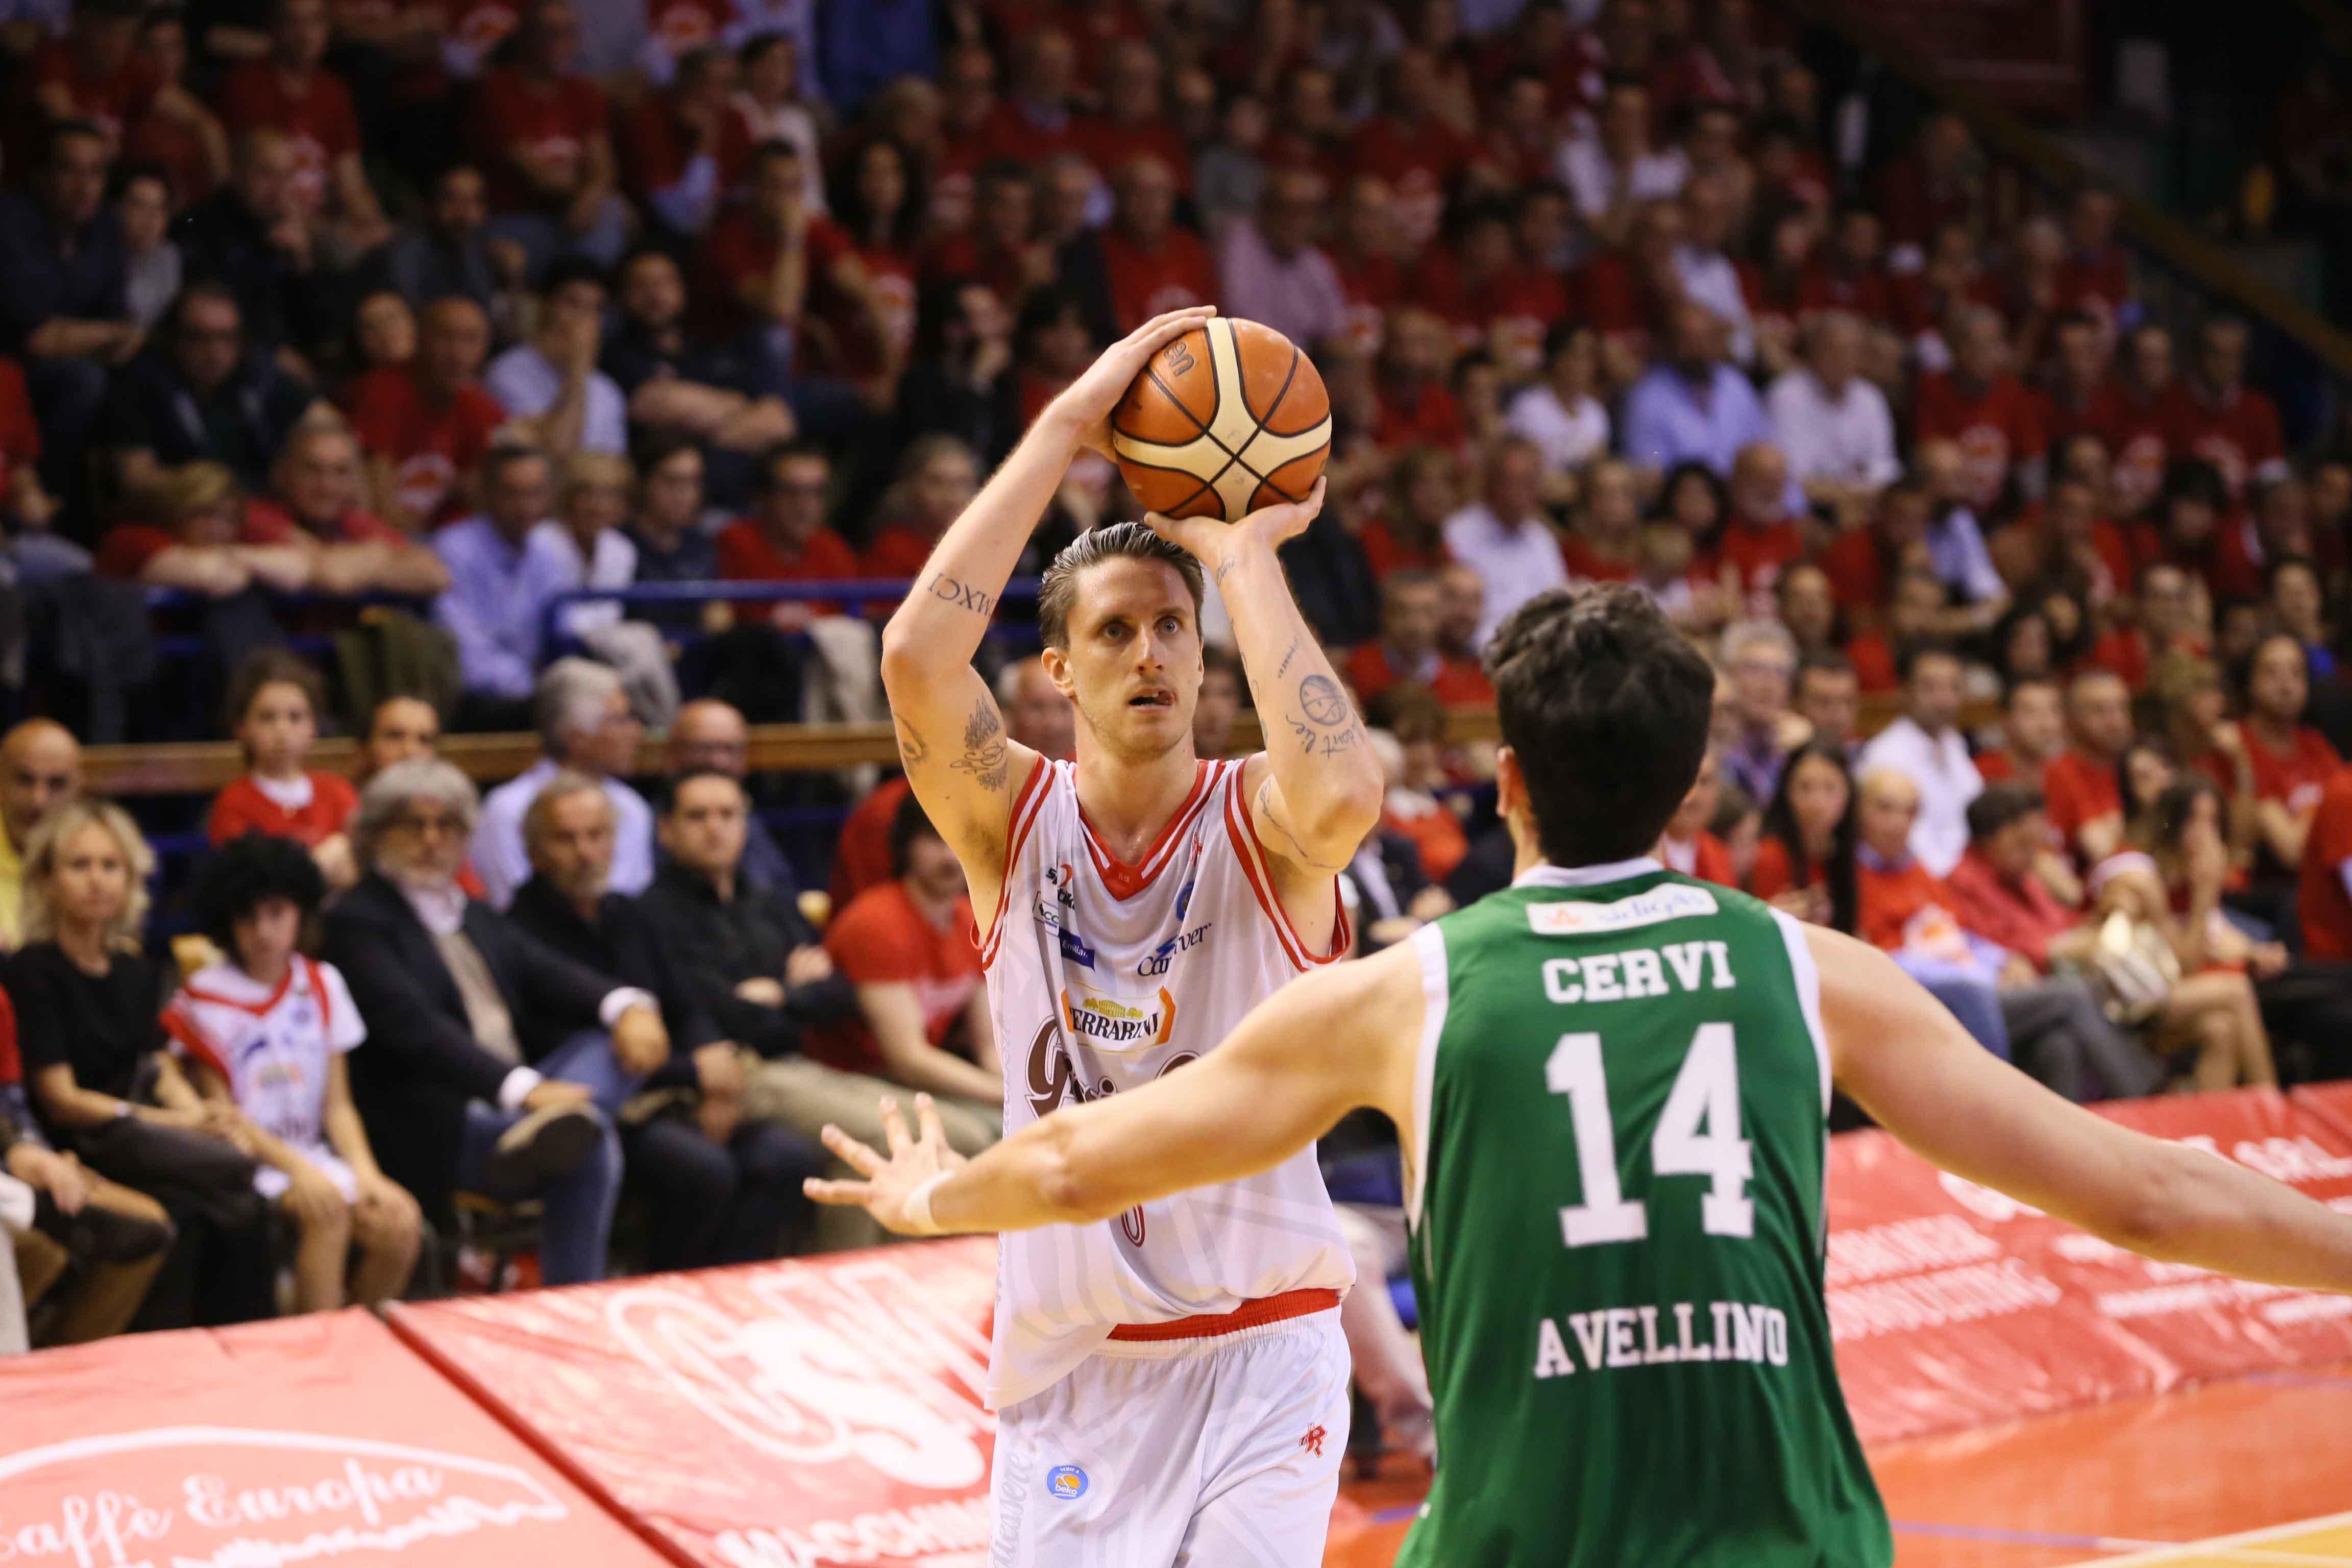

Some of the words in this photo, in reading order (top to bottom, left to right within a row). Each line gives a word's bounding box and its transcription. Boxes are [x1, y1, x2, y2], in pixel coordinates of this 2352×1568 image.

[1541, 941, 1736, 1004] CERVI
[1070, 1007, 1159, 1041] ERRARINI
[1545, 1022, 1755, 1248] 14
[1534, 1301, 1788, 1379] AVELLINO
[0, 1489, 174, 1568] affè
[182, 1456, 443, 1527] Europa
[1055, 1483, 1078, 1495] beko
